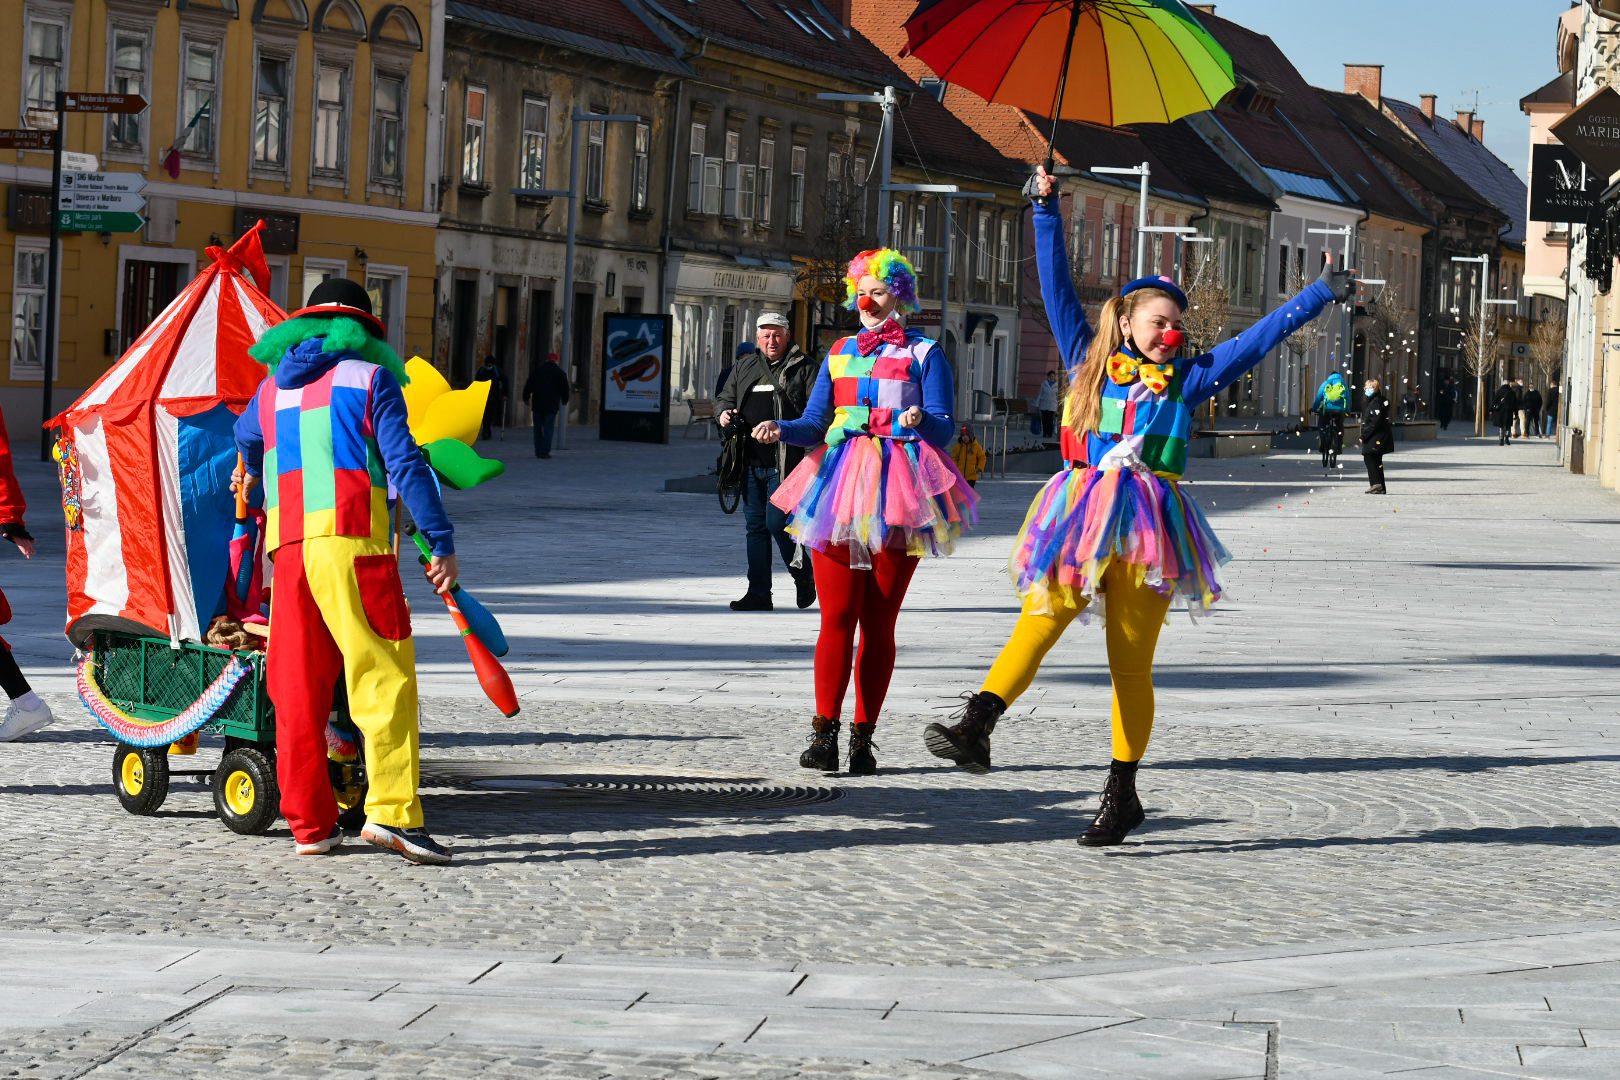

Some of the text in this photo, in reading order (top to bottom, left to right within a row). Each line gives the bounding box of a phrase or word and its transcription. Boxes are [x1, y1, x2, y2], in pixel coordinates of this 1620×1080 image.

[1576, 125, 1620, 139] MARIB
[88, 173, 104, 182] Maribor
[102, 194, 121, 203] Mariboru
